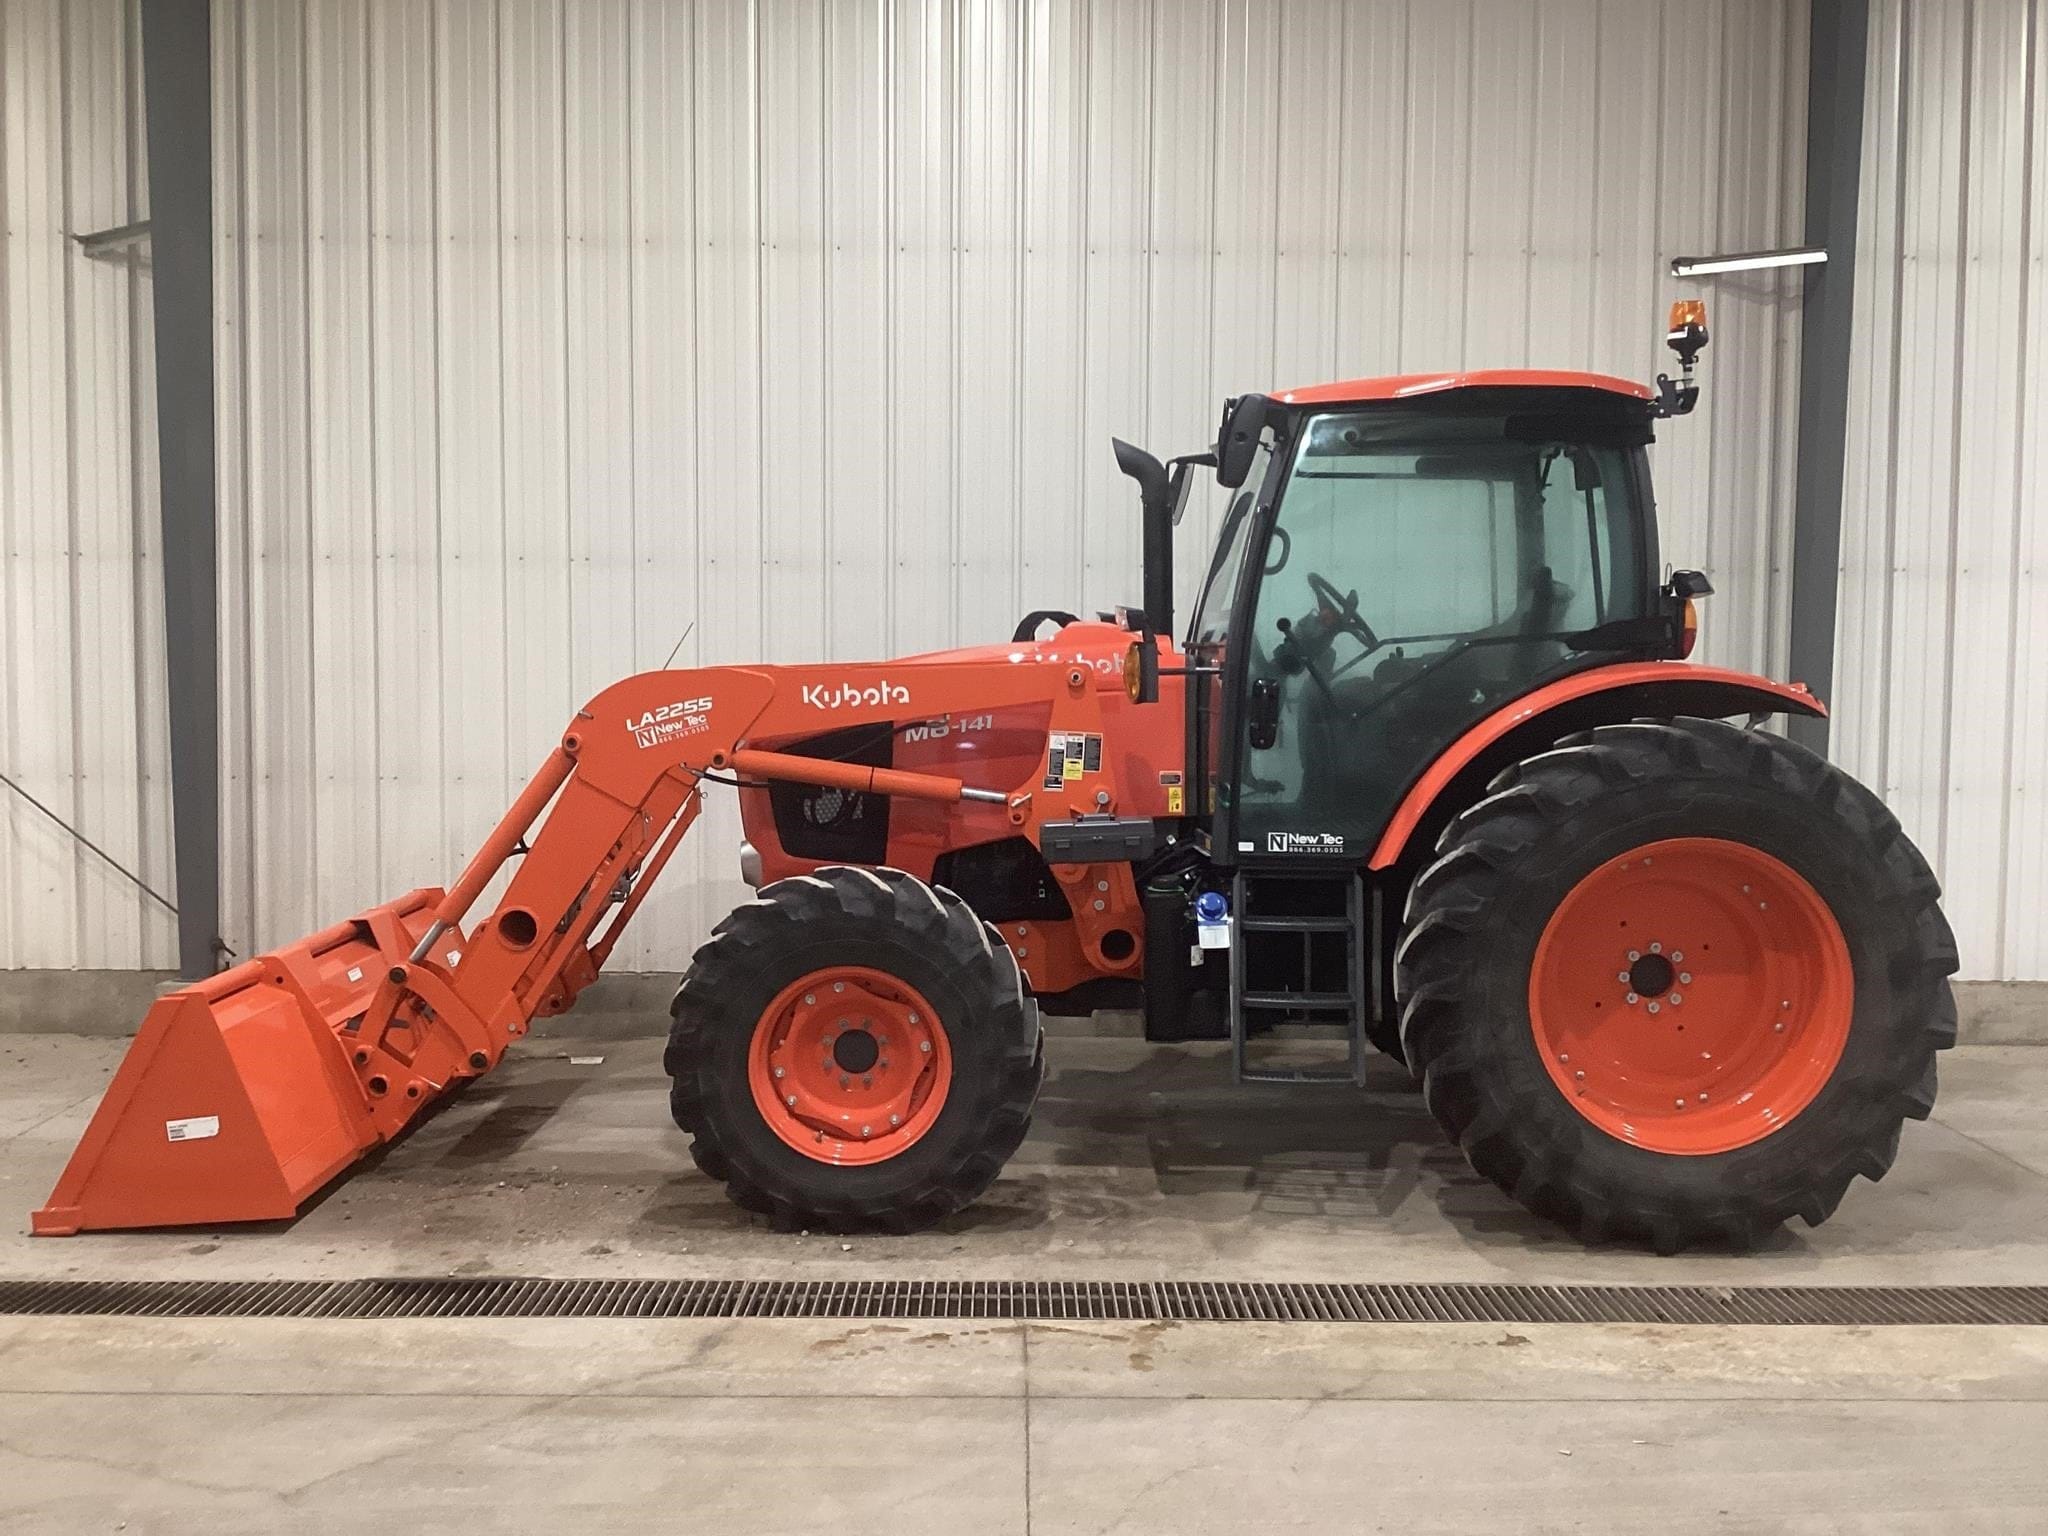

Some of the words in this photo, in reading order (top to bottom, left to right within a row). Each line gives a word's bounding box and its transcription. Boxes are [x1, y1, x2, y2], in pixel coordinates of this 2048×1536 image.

[802, 680, 910, 709] Kubota
[626, 697, 712, 731] LA2255
[655, 720, 683, 735] New
[684, 714, 706, 726] Tec
[1289, 833, 1319, 844] New
[1320, 833, 1344, 844] Tec
